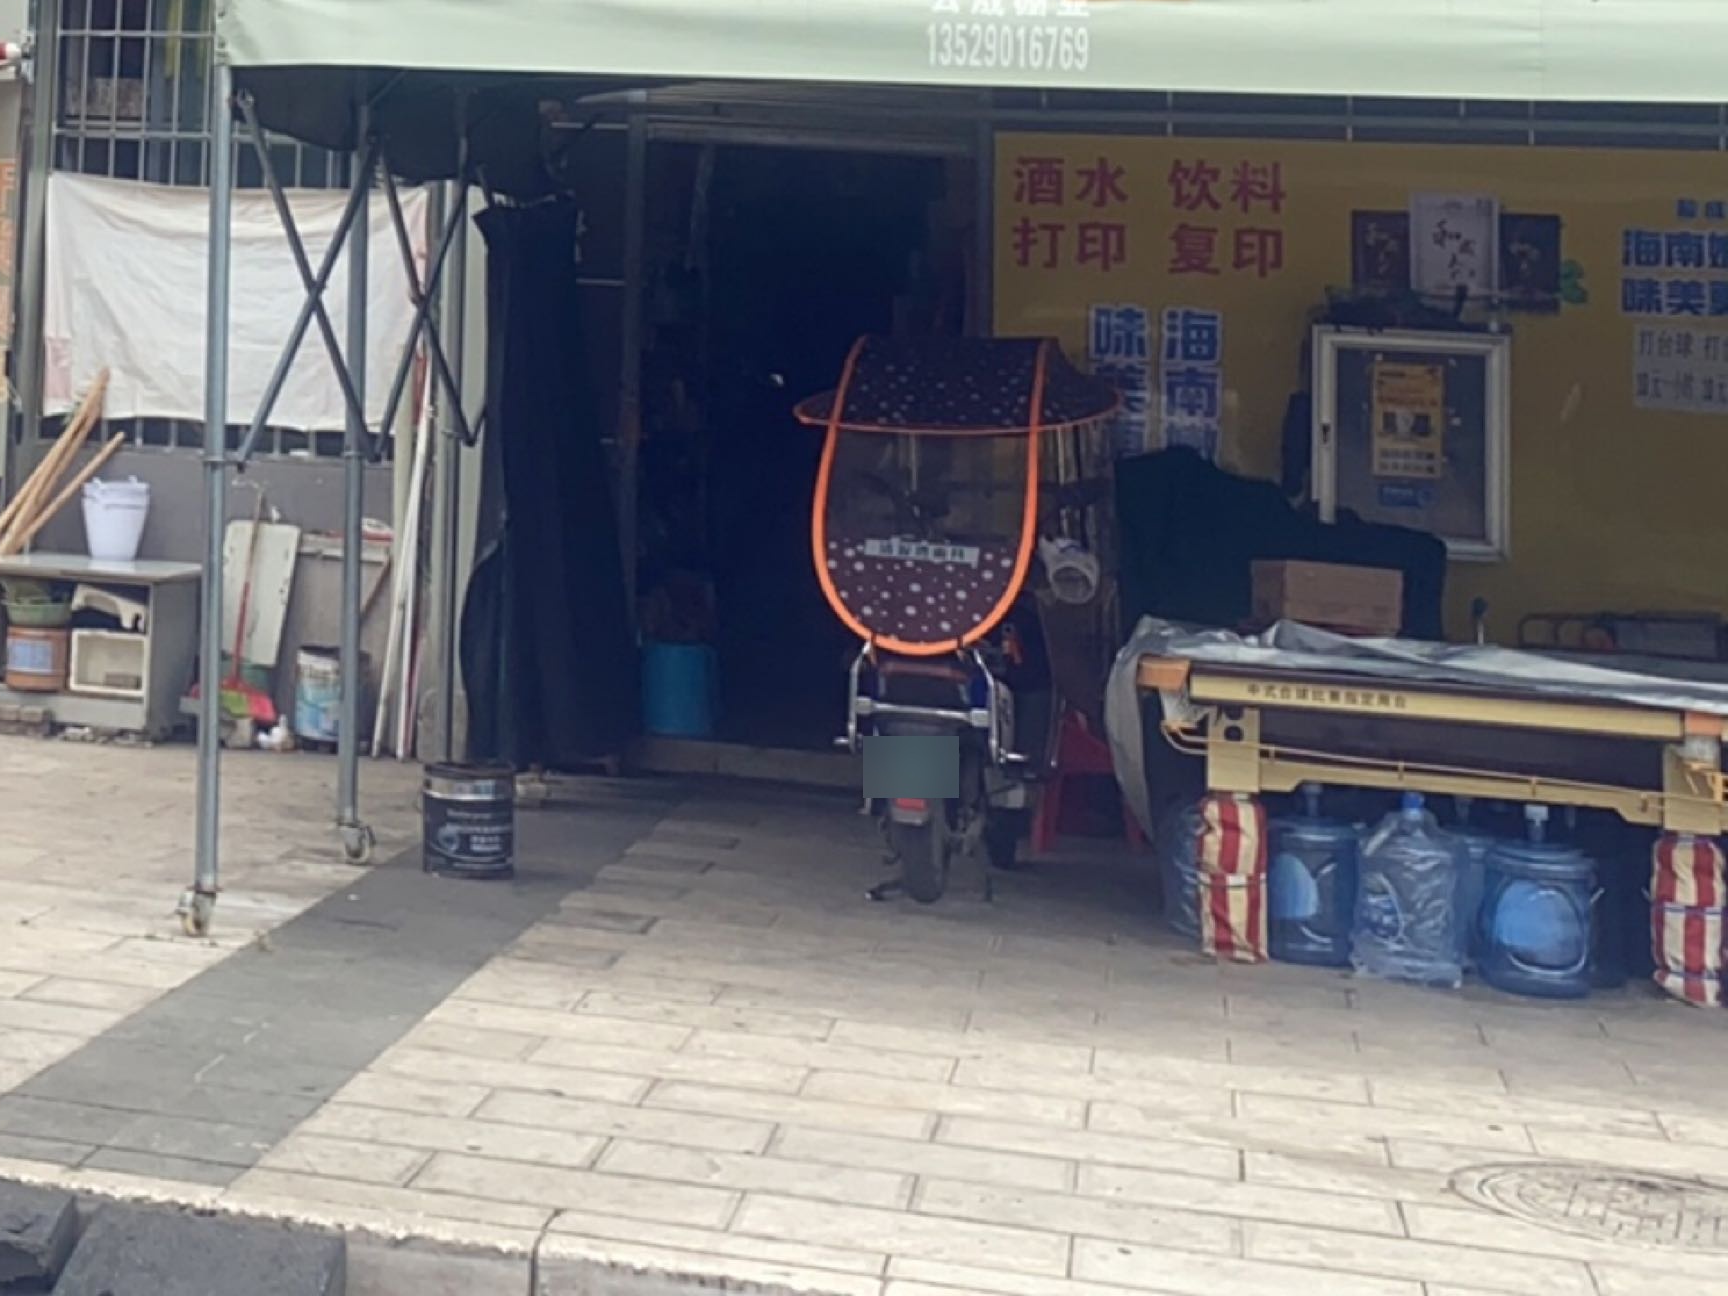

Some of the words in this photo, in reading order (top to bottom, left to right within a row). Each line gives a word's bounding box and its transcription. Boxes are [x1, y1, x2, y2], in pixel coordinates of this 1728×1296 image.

[927, 22, 1090, 71] 13529016769
[1013, 155, 1129, 207] 酒水
[1168, 158, 1286, 213] 饮料
[1012, 218, 1129, 273] 打印
[1168, 224, 1285, 278] 复印
